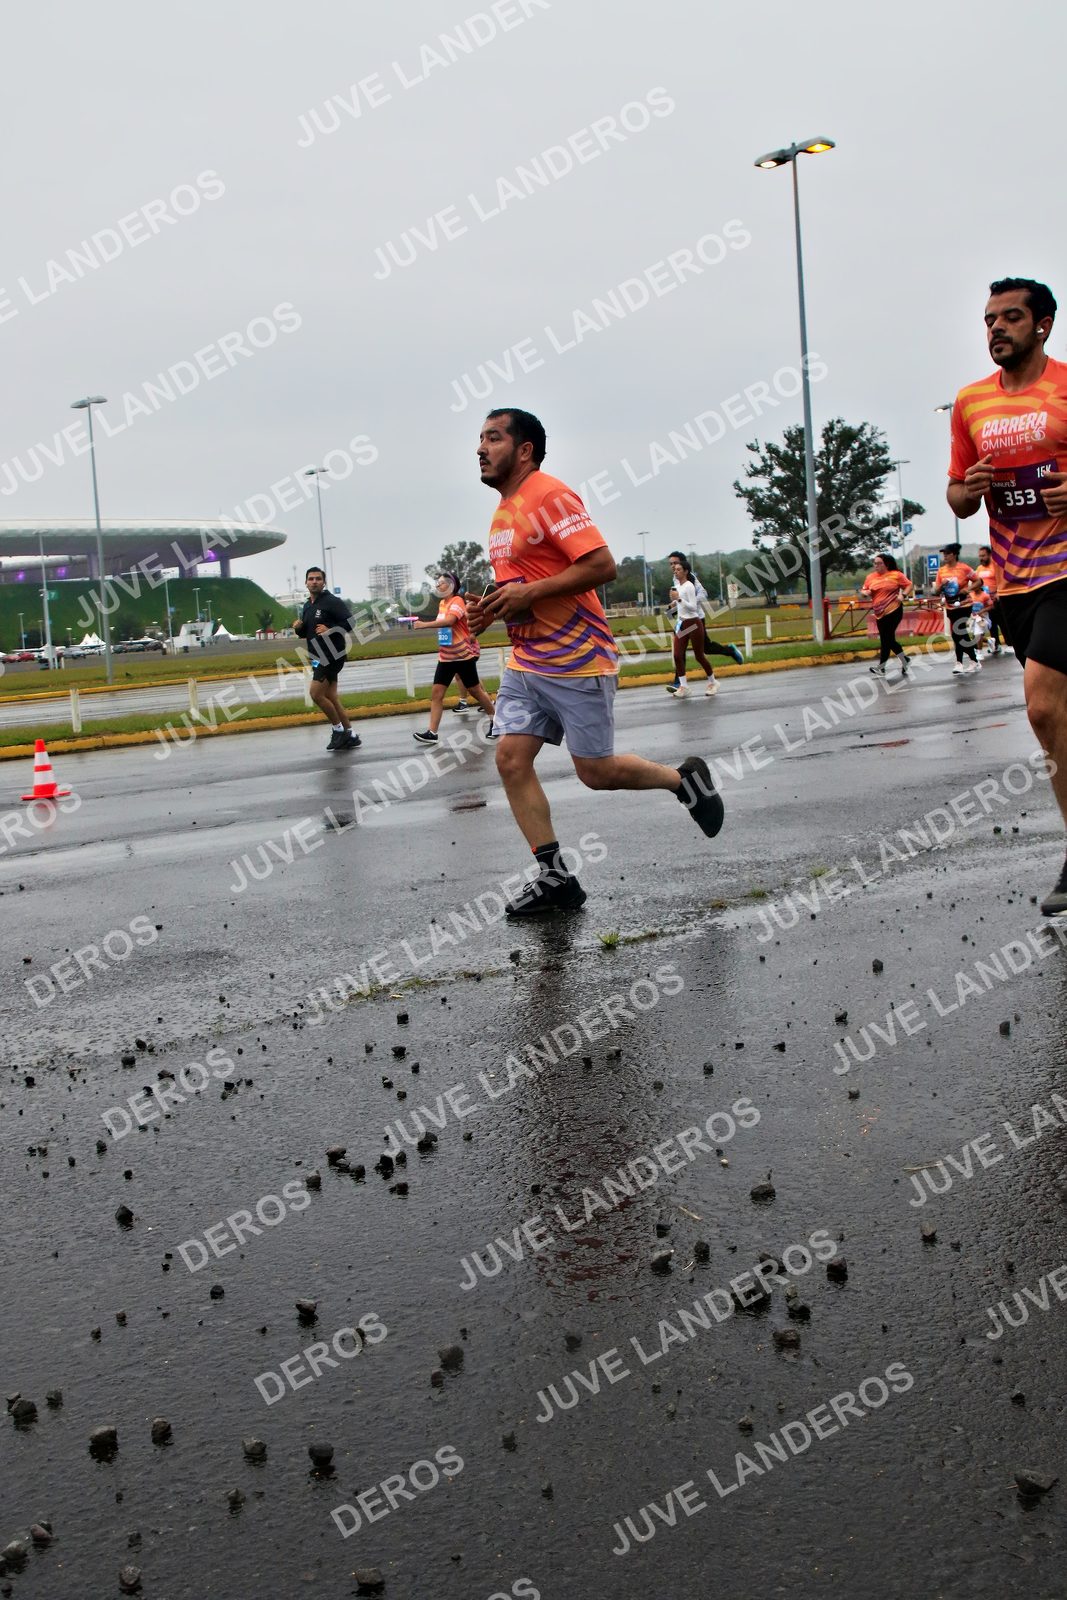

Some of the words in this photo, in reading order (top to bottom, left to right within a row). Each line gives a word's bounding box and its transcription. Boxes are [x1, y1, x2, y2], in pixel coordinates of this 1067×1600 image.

[982, 411, 1048, 438] CARRERA
[982, 432, 1031, 451] OMNILIFE
[1004, 488, 1037, 507] 353
